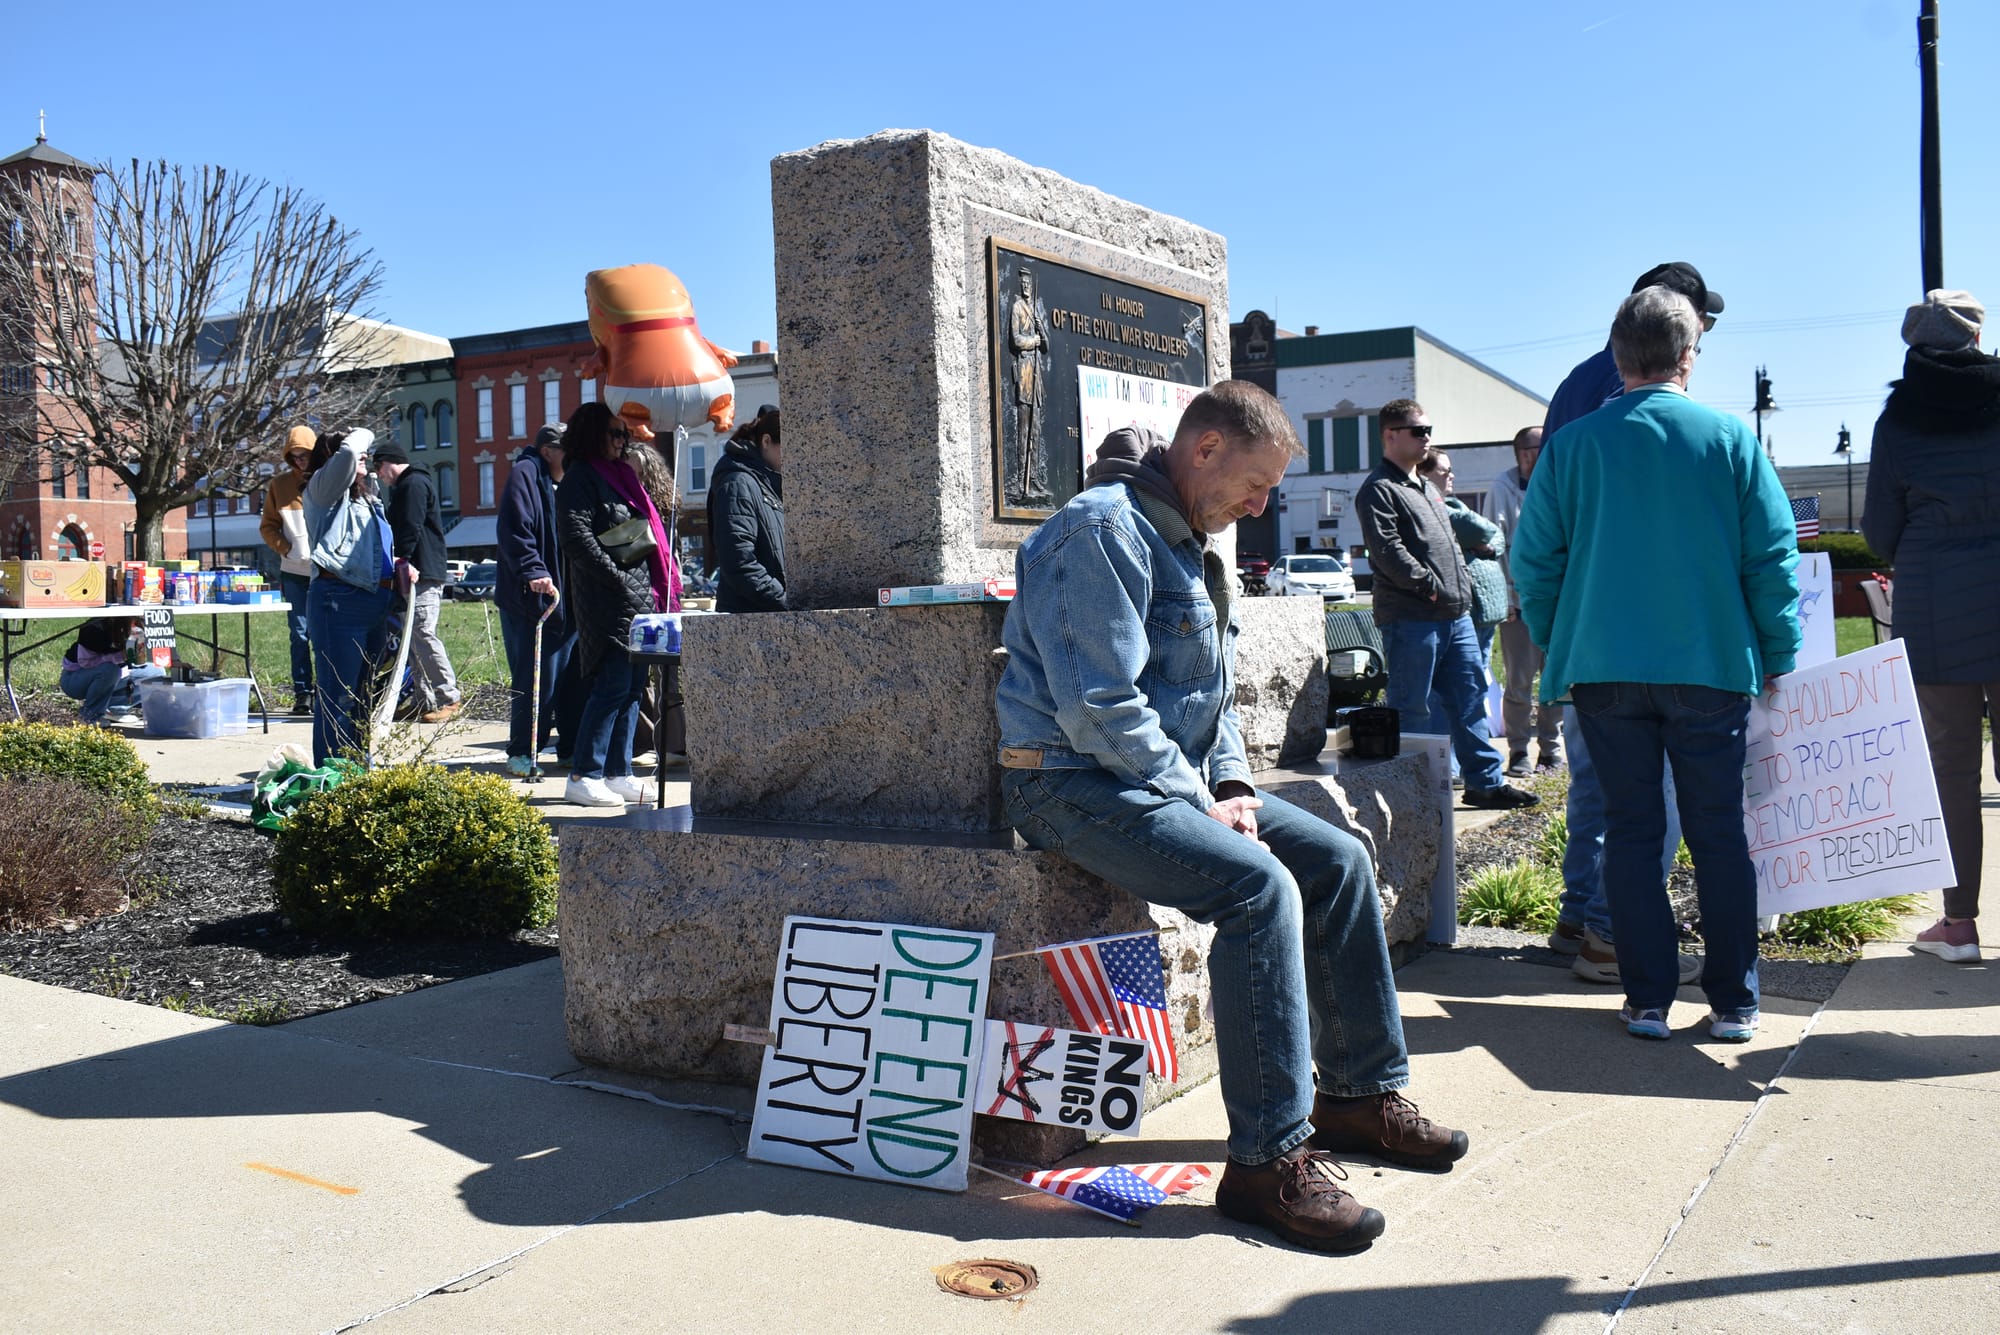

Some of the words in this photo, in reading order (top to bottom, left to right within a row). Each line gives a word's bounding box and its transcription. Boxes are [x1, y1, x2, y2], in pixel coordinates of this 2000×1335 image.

[1102, 292, 1112, 310] IN
[1115, 295, 1144, 318] HONOR
[1052, 308, 1067, 328] OF
[1070, 311, 1091, 334] THE
[1093, 318, 1119, 342] CIVIL
[1121, 324, 1141, 346] WAR
[1143, 330, 1188, 358] SOLDIERS
[1081, 346, 1092, 362] OF
[1096, 348, 1133, 371] DECATUR
[1086, 374, 1108, 399] WHY
[1115, 374, 1131, 403] I'M
[1139, 380, 1154, 405] NOT
[1161, 384, 1168, 408] A
[1066, 426, 1079, 438] THE
[144, 609, 171, 625] FOOD
[144, 626, 175, 637] DONATION
[147, 637, 176, 649] STATION
[1767, 655, 1903, 738] SHOULDN'T
[1759, 753, 1792, 791] TO
[1792, 719, 1911, 782] PROTECT
[1773, 850, 1817, 889] OUR
[1820, 817, 1941, 878] PRESIDENT
[761, 922, 883, 1172] LIBERTY
[867, 929, 983, 1179] DEFEND
[1058, 1033, 1103, 1126] KINGS
[1100, 1040, 1145, 1131] NO
